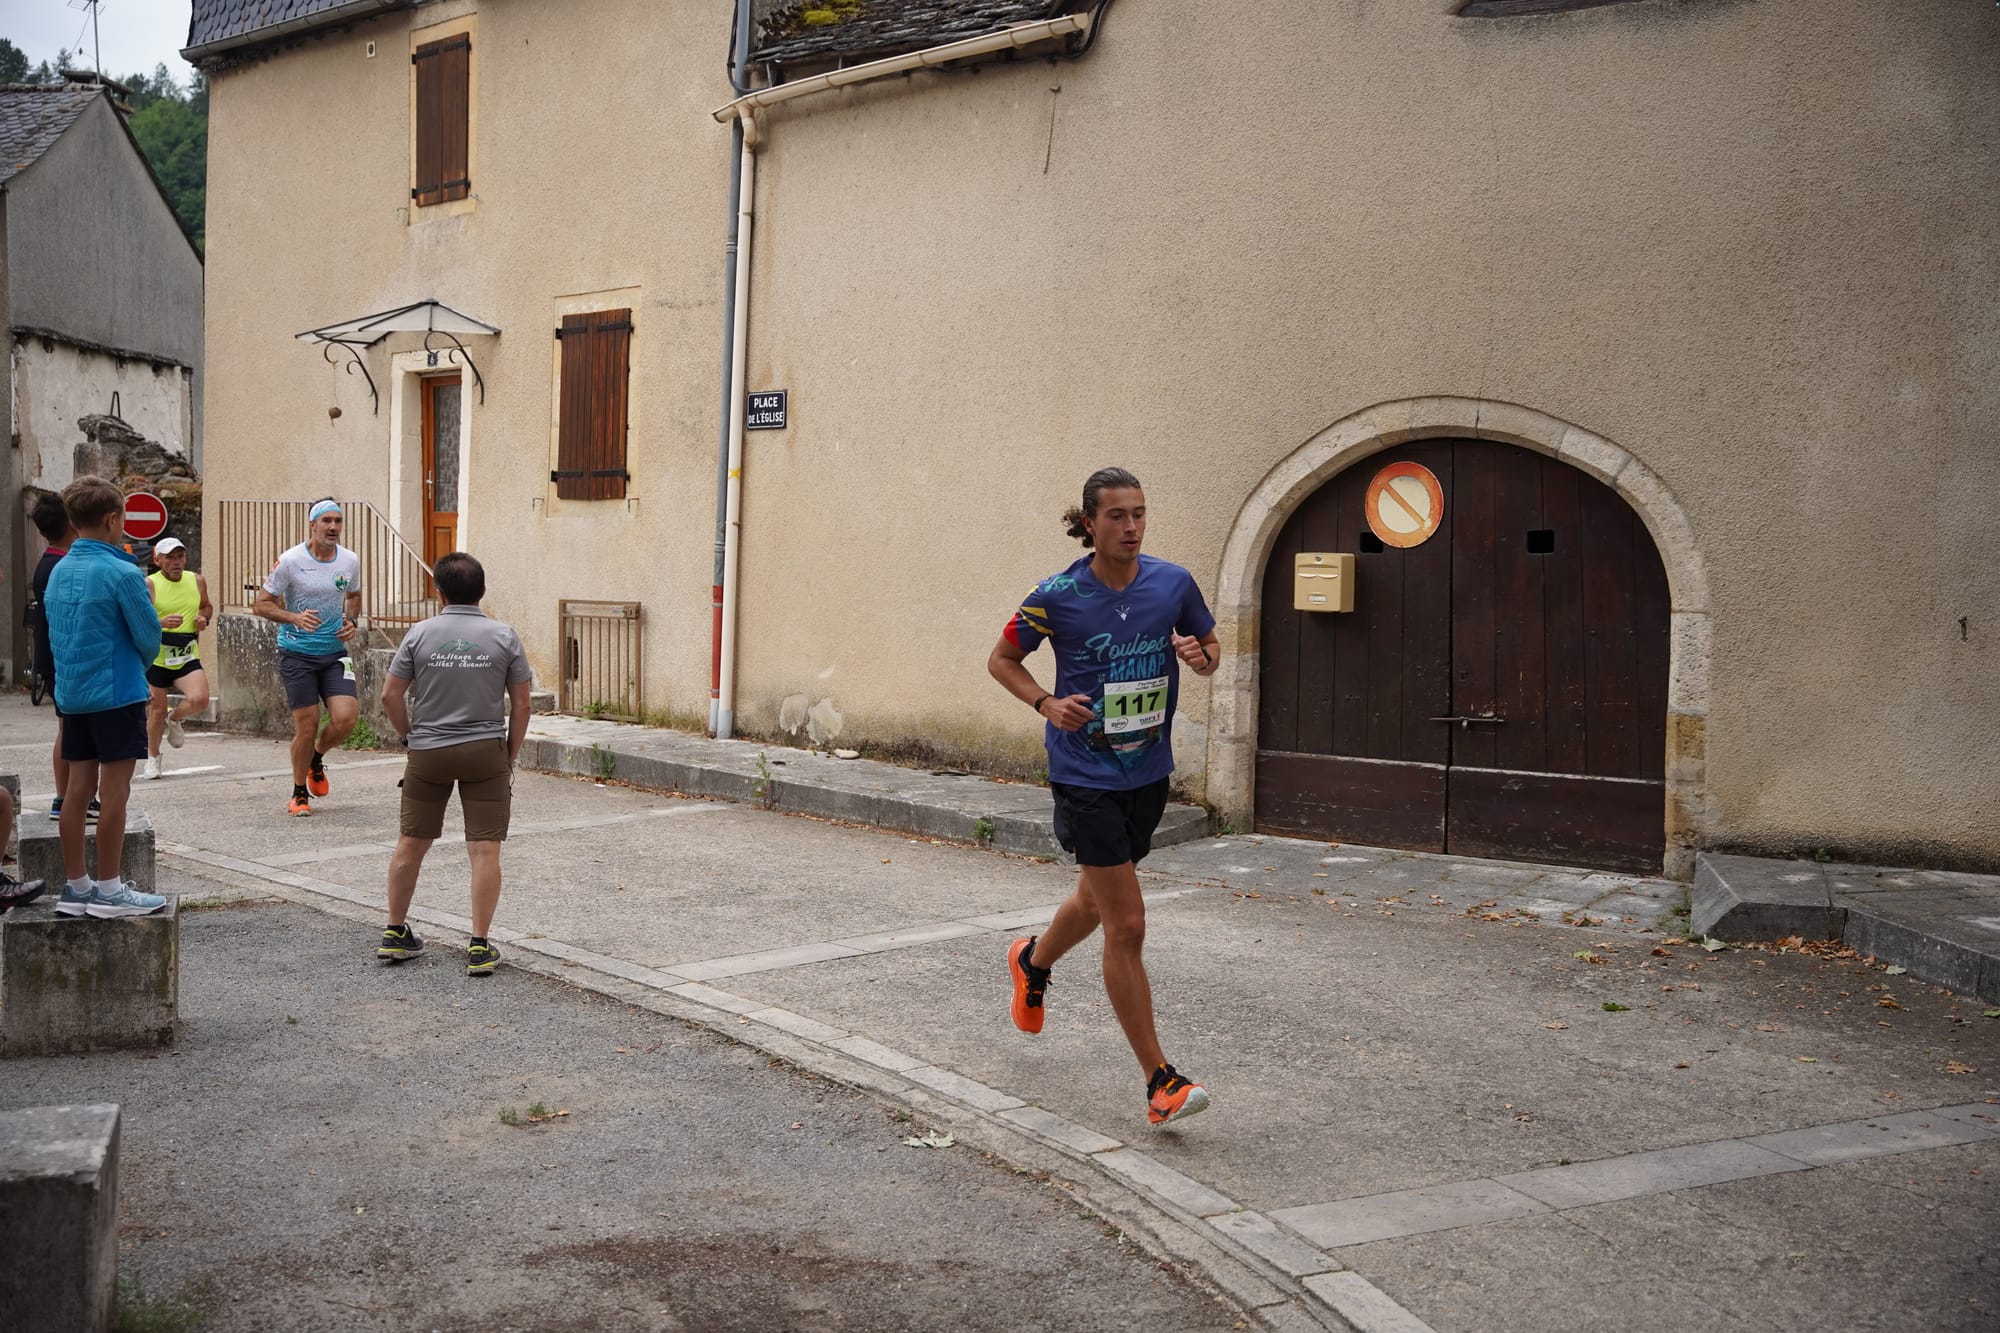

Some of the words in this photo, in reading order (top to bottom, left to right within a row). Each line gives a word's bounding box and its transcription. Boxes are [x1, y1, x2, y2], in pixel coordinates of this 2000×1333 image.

[754, 397, 778, 408] PLACE
[748, 414, 755, 423] DE
[756, 410, 783, 423] L'ÉGLISE
[170, 646, 191, 657] 124
[1085, 633, 1168, 662] Foulées
[430, 653, 472, 662] Challenge
[1115, 691, 1161, 716] 117
